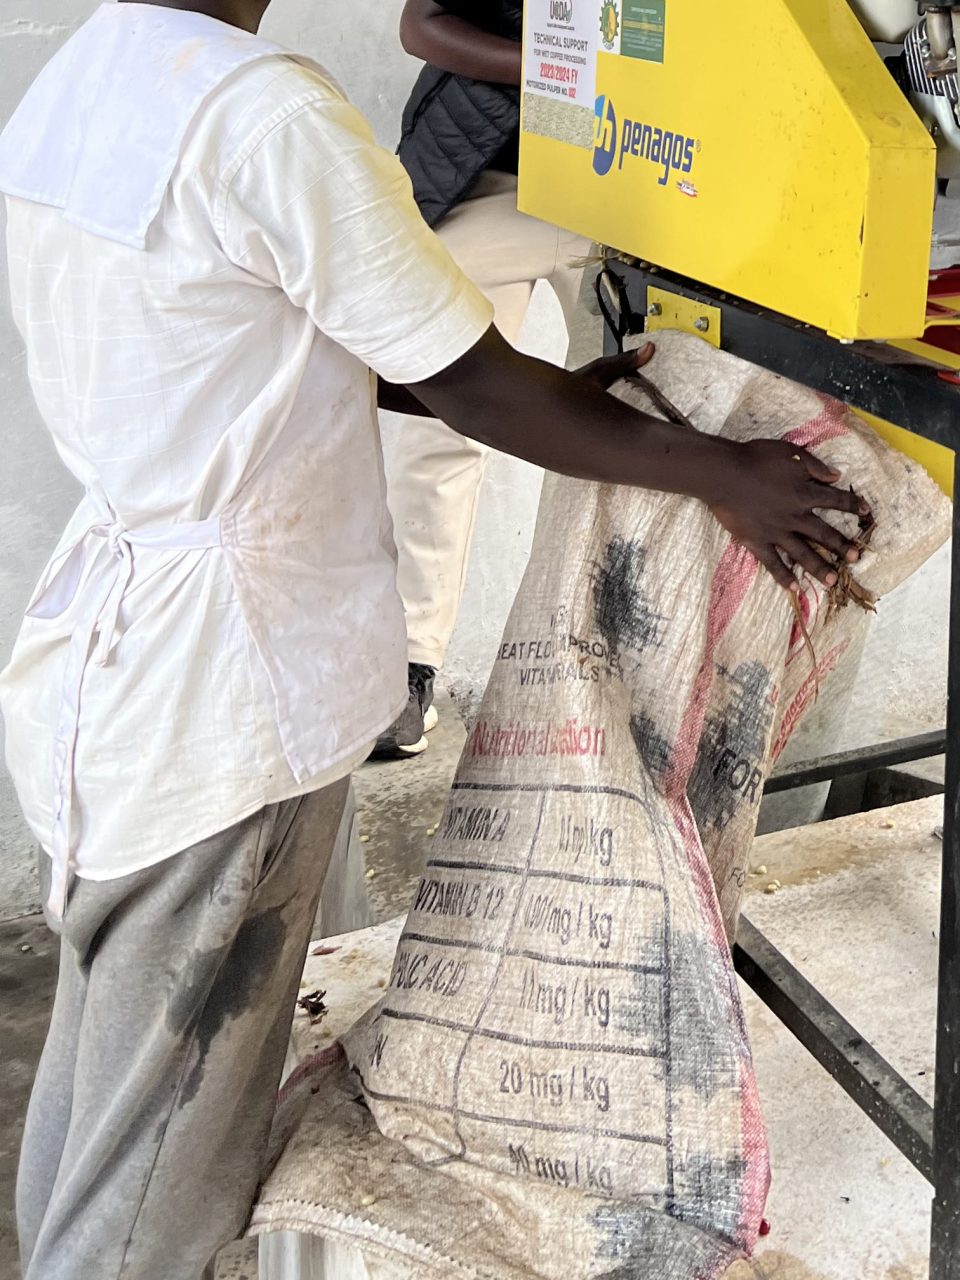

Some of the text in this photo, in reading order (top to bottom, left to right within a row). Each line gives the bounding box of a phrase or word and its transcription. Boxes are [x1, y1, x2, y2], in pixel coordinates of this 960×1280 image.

[534, 32, 562, 48] TECHNICAL
[563, 37, 588, 52] SUPPORT
[550, 51, 564, 61] COFFEE
[564, 53, 586, 66] PROCESSING
[547, 83, 560, 94] PULPER
[571, 69, 578, 84] FY
[618, 118, 695, 186] penagos
[584, 977, 611, 1028] kg
[500, 1060, 523, 1095] 20
[529, 1067, 562, 1108] mg
[583, 1066, 611, 1113] kg
[535, 1157, 568, 1189] mg
[585, 1155, 613, 1197] kg
